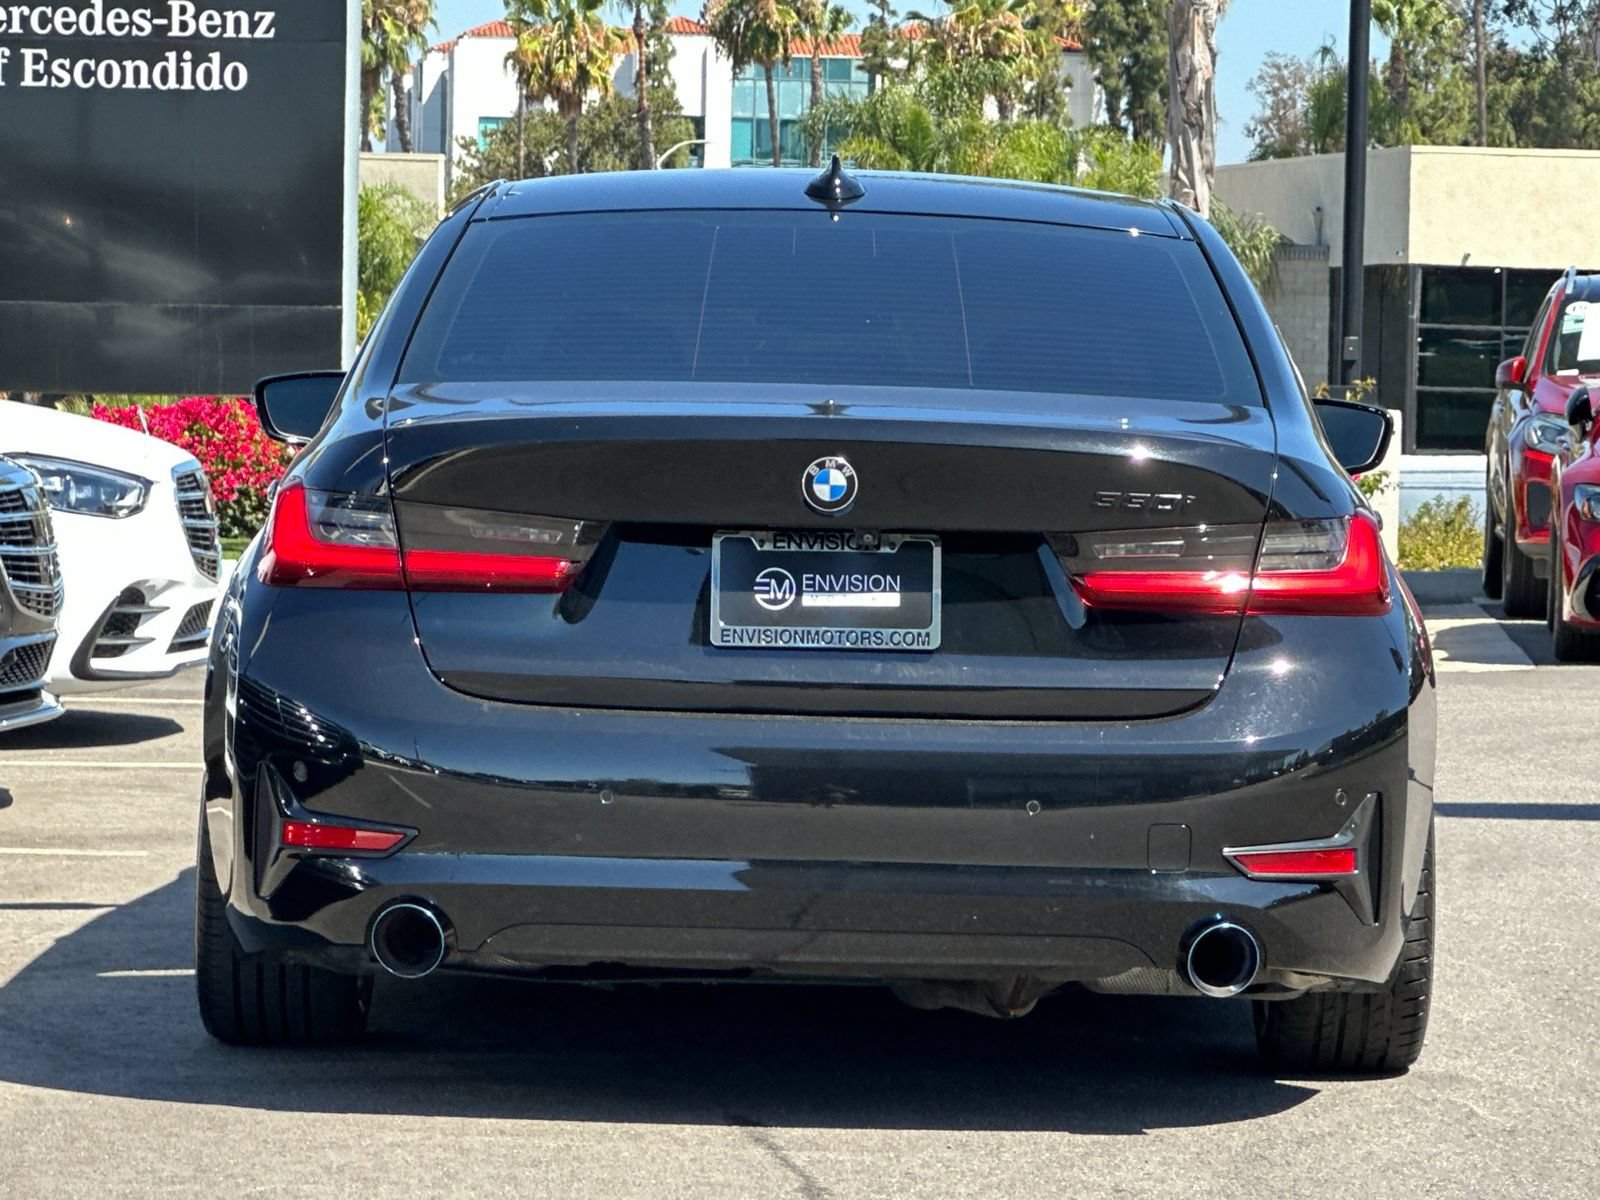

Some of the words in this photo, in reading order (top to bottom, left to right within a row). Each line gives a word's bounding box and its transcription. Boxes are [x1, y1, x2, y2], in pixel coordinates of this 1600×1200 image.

[20, 48, 249, 91] Escondido
[808, 459, 853, 477] BMW
[802, 573, 901, 592] ENVISION
[720, 627, 931, 648] ENVISIONMOTORS.COM
